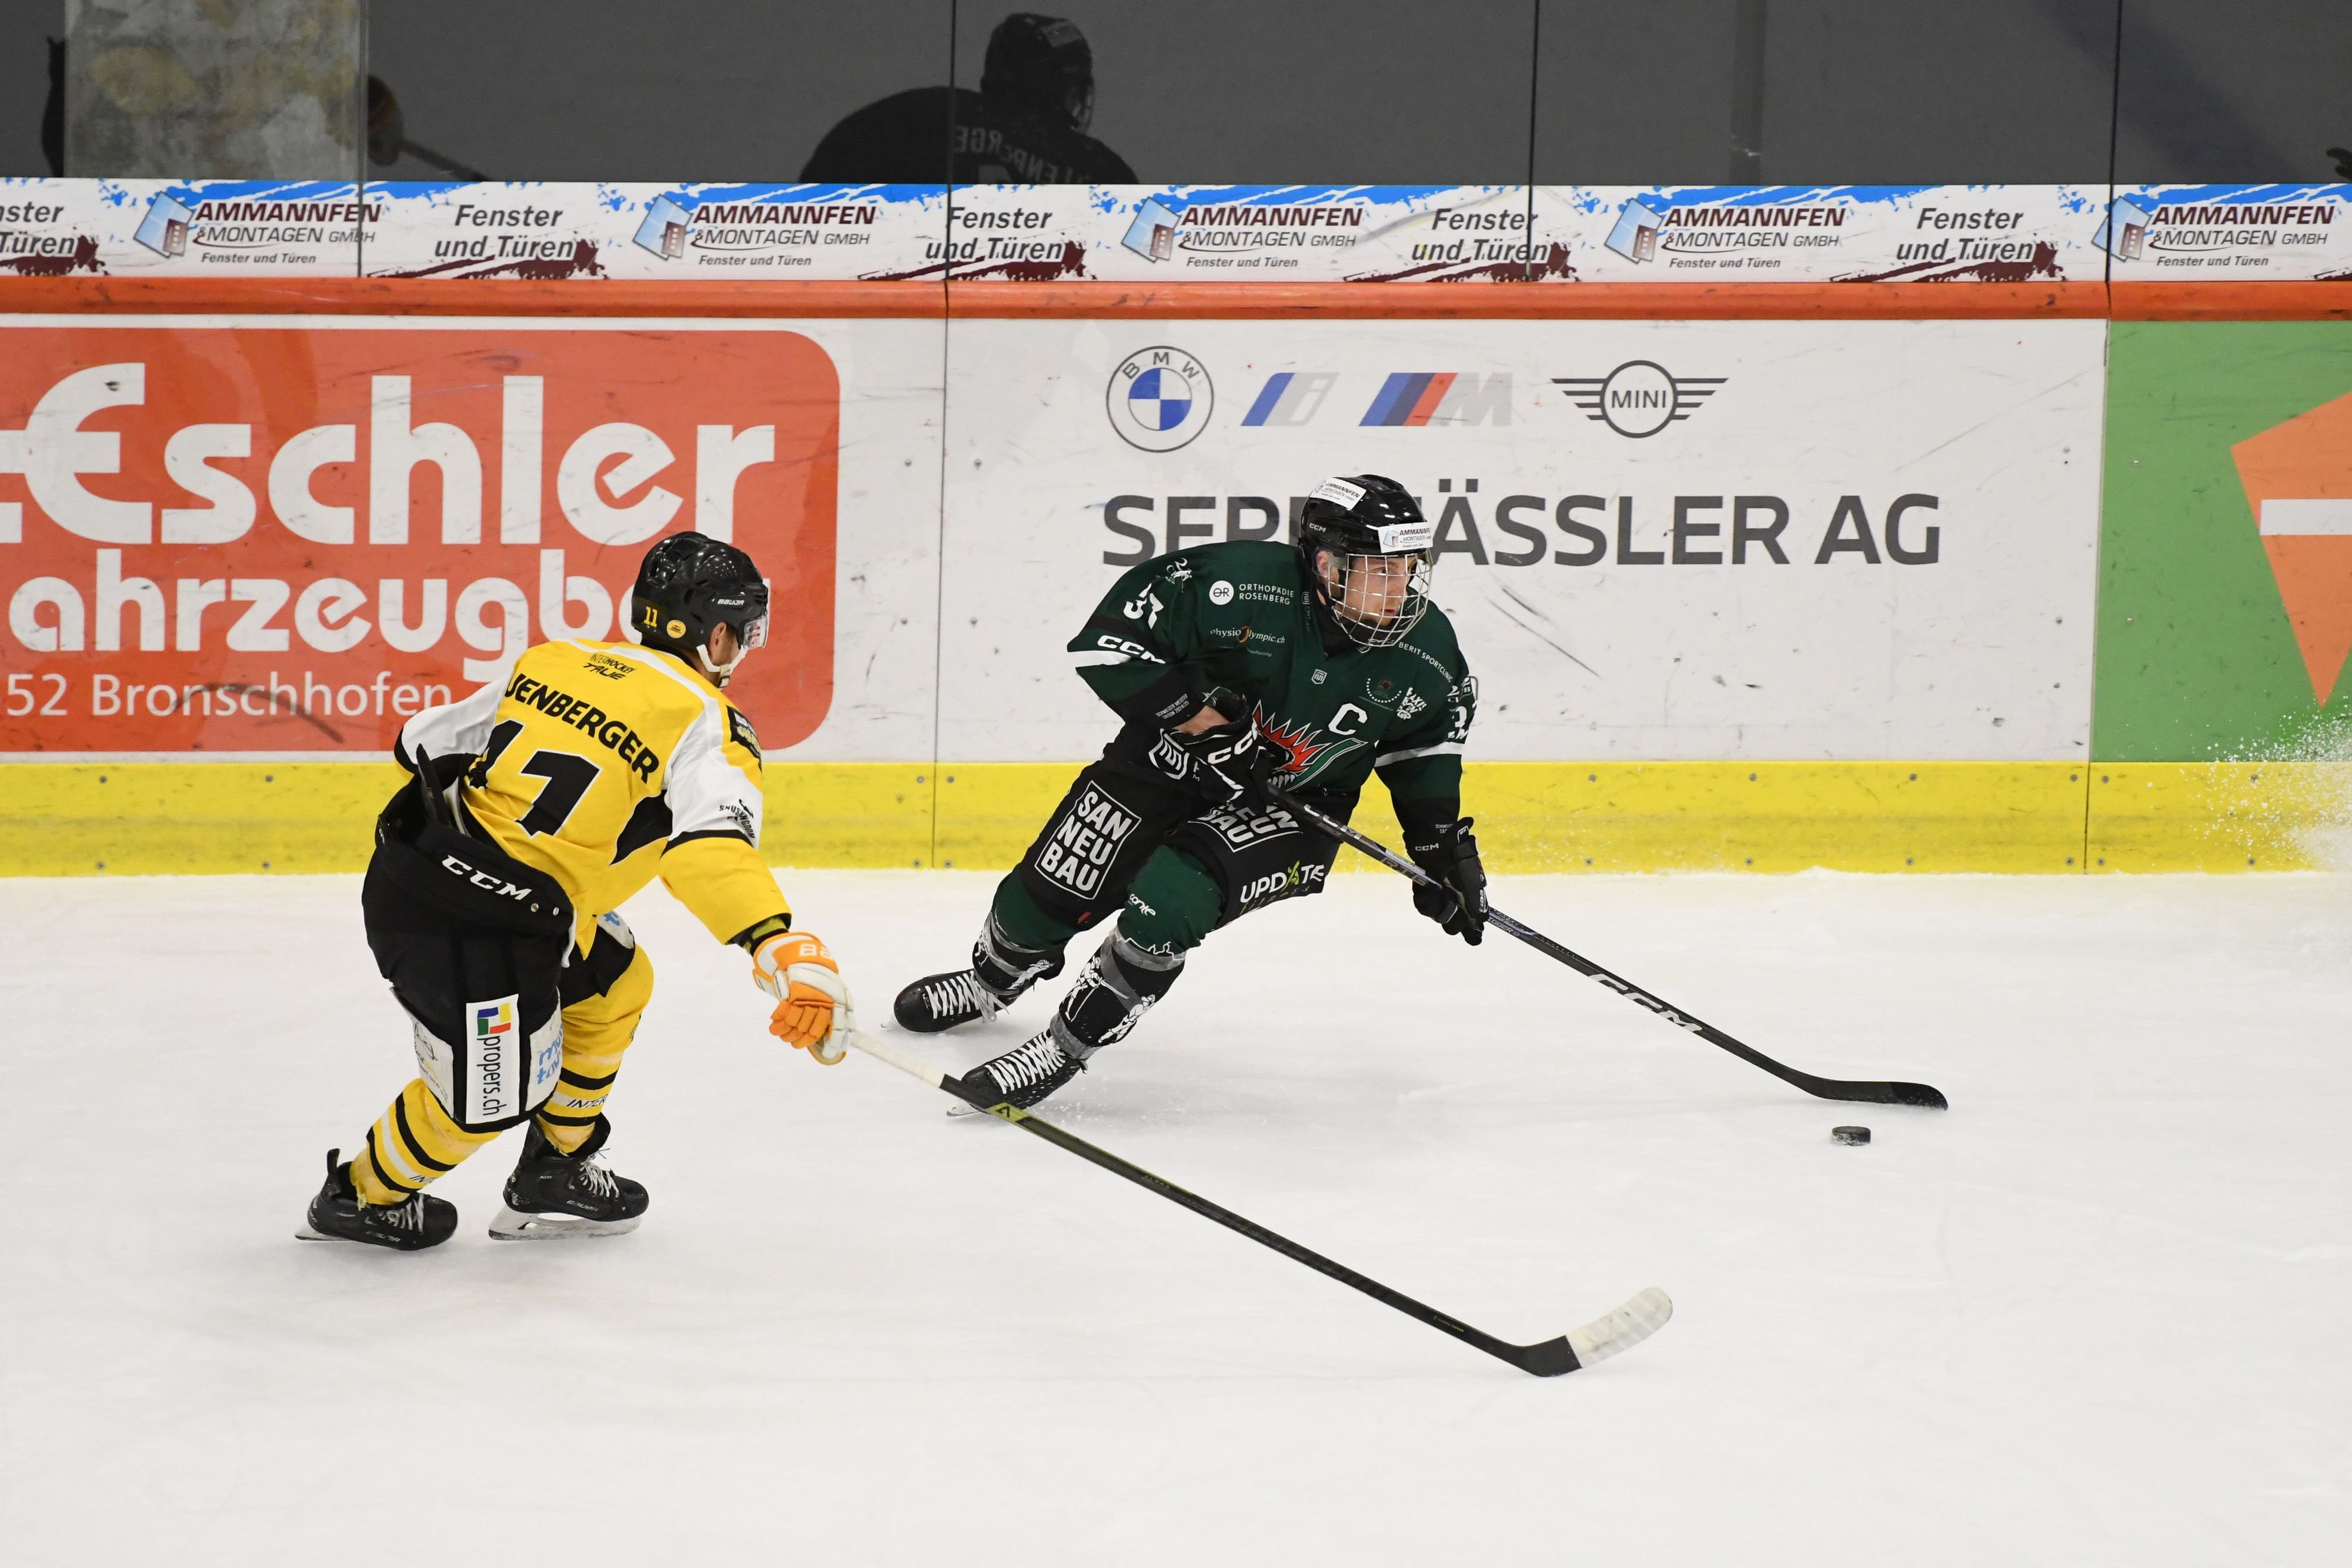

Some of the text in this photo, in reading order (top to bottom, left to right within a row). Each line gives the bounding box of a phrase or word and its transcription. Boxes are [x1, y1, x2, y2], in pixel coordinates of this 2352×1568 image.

[195, 203, 380, 222] AMMANNFEN
[455, 205, 563, 226] Fenster
[693, 206, 876, 224] AMMANNFEN
[946, 207, 1052, 228] Fenster
[1182, 208, 1362, 226] AMMANNFEN
[1665, 209, 1845, 226] AMMANNFEN
[1917, 208, 2023, 229] Fenster
[2152, 206, 2334, 225] AMMANNFEN
[329, 230, 375, 243] GMH
[435, 235, 573, 258] und Türen
[824, 234, 869, 245] GMBH
[1311, 236, 1356, 246] GMBH
[1793, 236, 1839, 247] GMBH
[2281, 234, 2327, 245] GMBH
[201, 252, 316, 264] Fenster und Türen
[926, 238, 1063, 259] und Türen
[1412, 239, 1465, 260] und
[1897, 238, 2033, 260] und Türen
[699, 255, 811, 265] Fenster und Türen
[1187, 256, 1298, 267] Fenster und Türen
[1670, 258, 1780, 268] Fenster und Türen
[2157, 256, 2268, 266] Fenster und Türen
[1122, 350, 1200, 380] BMW
[1611, 390, 1667, 409] MINI
[1103, 478, 1940, 567] SEP ÄSSLER AG
[1309, 523, 1327, 533] CCM
[1239, 583, 1294, 598] ORTHOPÄDIE
[1239, 592, 1290, 606] ROSENBERG
[8, 548, 771, 683] ahrzeugb
[644, 606, 657, 627] 11
[1399, 642, 1454, 683] BERIT SPORTCLINIC
[7, 671, 452, 717] 52 Bronschhofen
[1328, 703, 1368, 735] C
[1078, 790, 1132, 841] SAN
[1057, 815, 1113, 865] NEU
[1415, 842, 1439, 851] CCM
[1041, 841, 1100, 891] BAU
[442, 854, 532, 901] CCM
[1240, 860, 1325, 903] UPDATE
[477, 1035, 507, 1116] propers.ch
